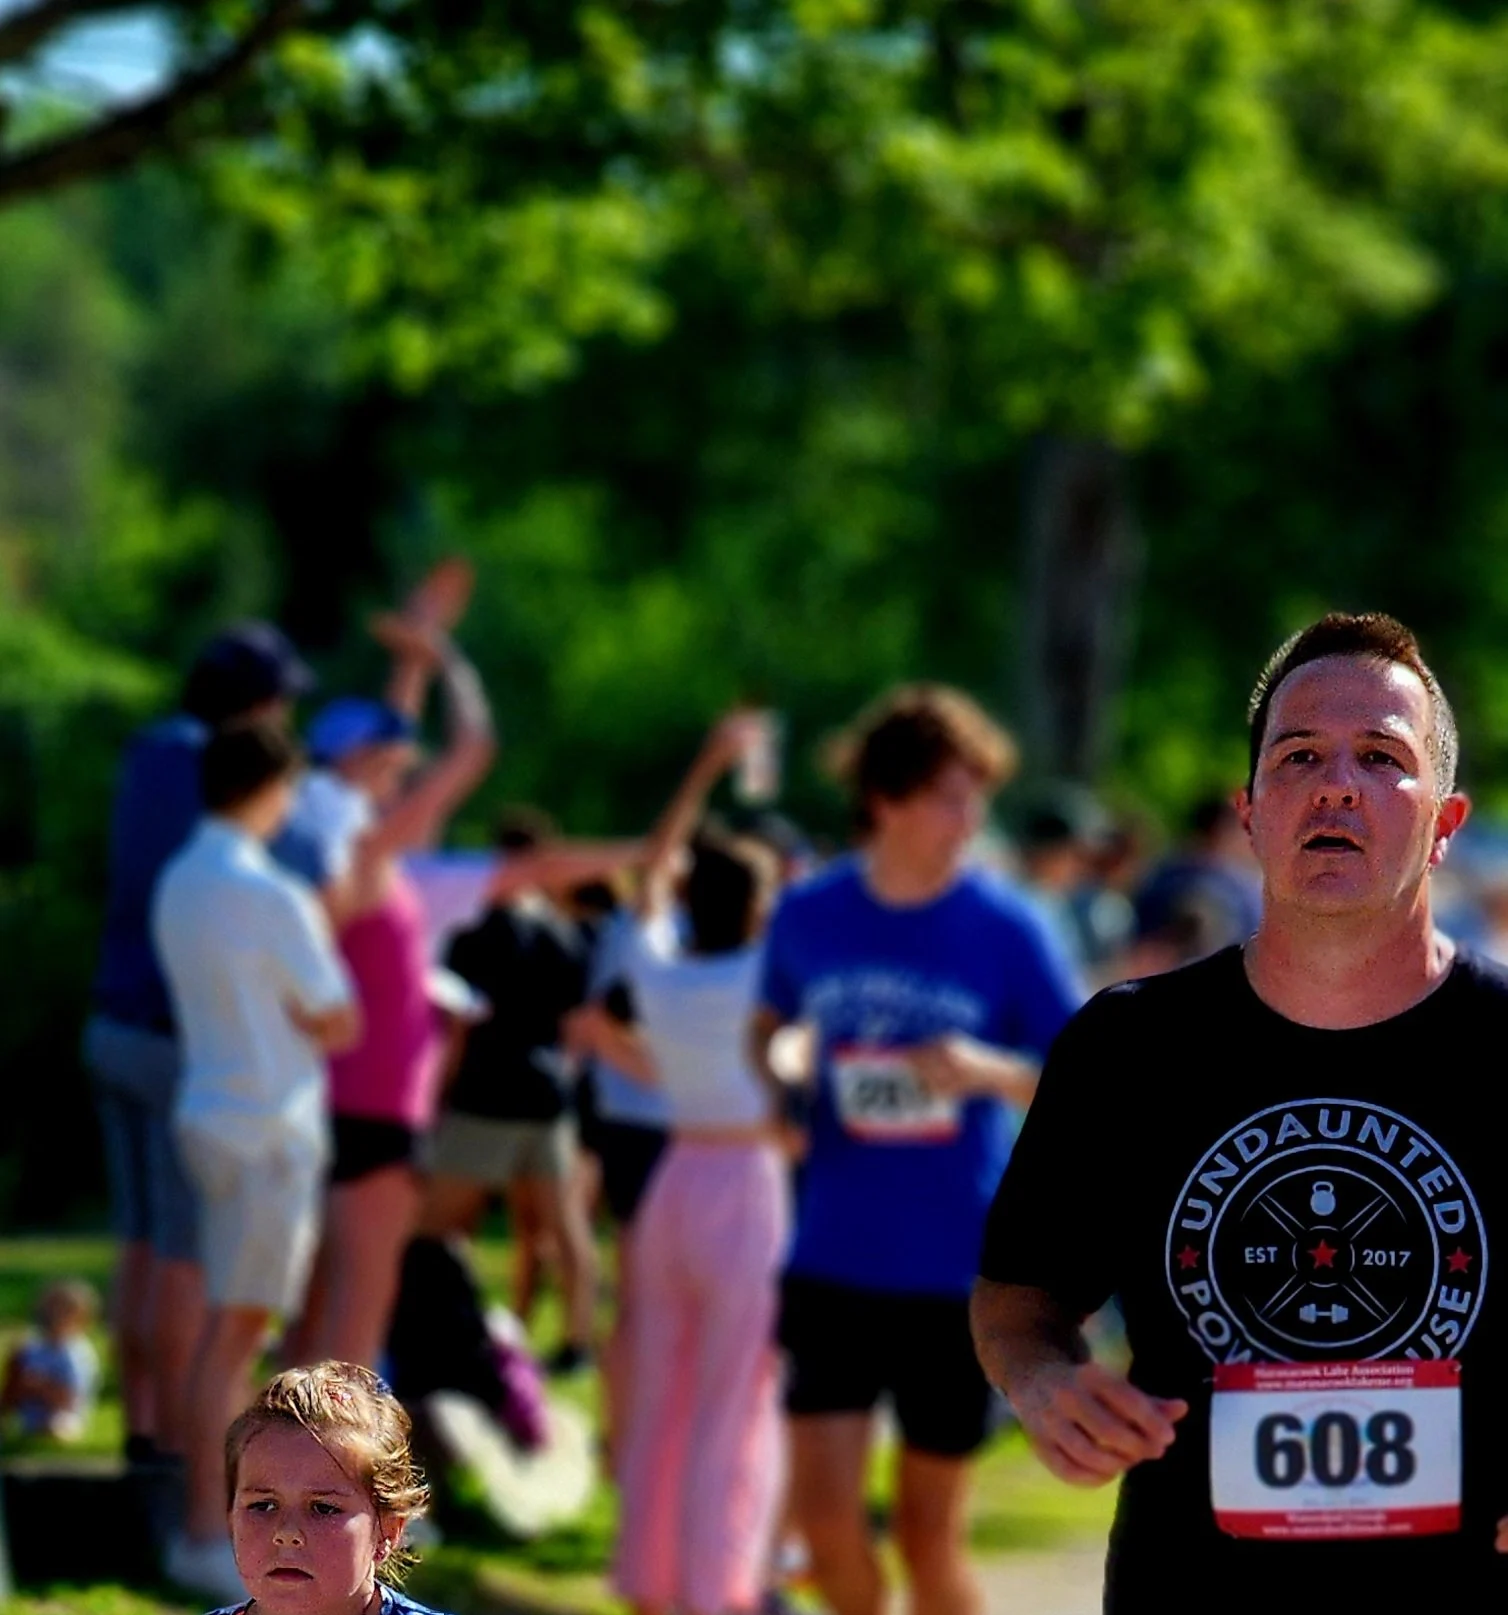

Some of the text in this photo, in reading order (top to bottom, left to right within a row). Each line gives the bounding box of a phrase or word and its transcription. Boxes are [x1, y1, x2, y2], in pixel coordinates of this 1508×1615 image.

[1181, 1108, 1466, 1234] UNDAUNTED
[1244, 1246, 1278, 1264] EST
[1362, 1249, 1411, 1268] 2017
[1351, 1364, 1414, 1377] Association
[1255, 1409, 1417, 1489] 608
